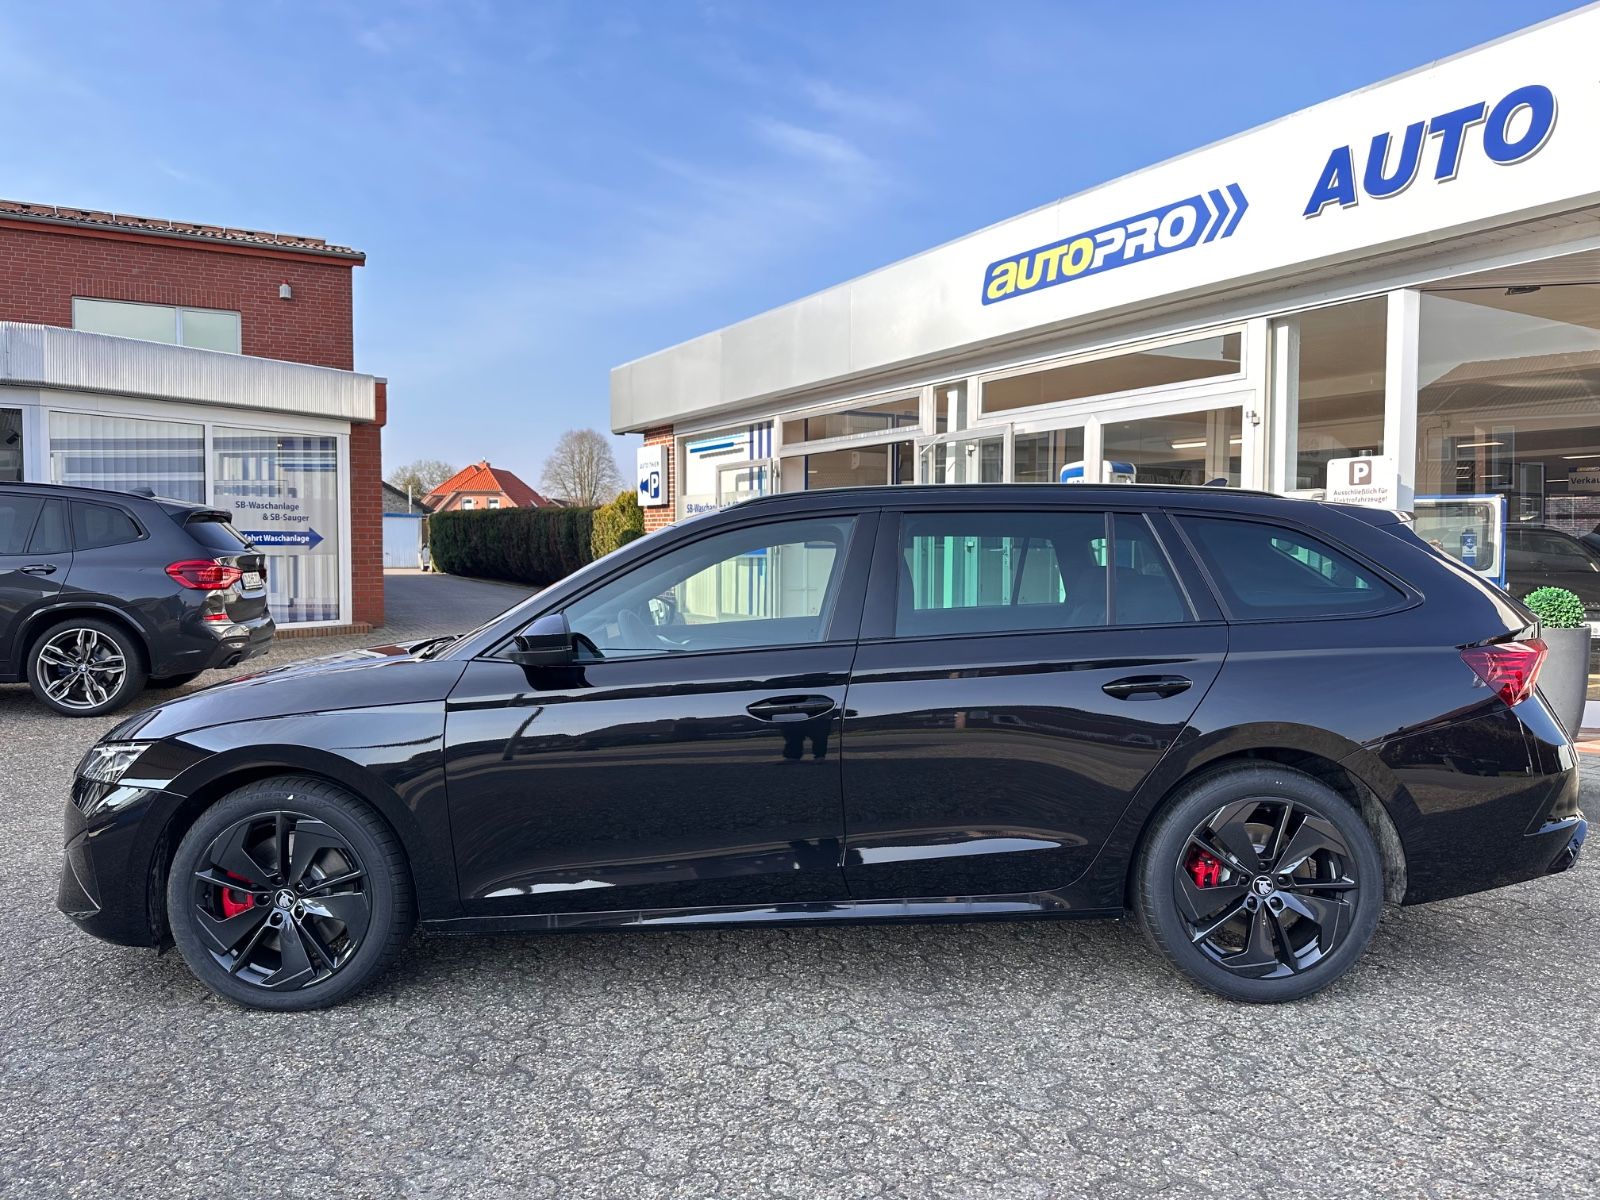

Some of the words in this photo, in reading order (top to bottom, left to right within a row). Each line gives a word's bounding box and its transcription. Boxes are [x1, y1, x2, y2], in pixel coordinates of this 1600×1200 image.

[1302, 84, 1559, 220] AUTO
[1353, 462, 1370, 484] P
[650, 473, 660, 497] P
[1333, 488, 1377, 496] Ausschließlich
[235, 500, 300, 512] SB-Waschanlage
[262, 513, 268, 521] &
[270, 513, 310, 523] SB-Sauger
[263, 534, 310, 544] Waschanlage
